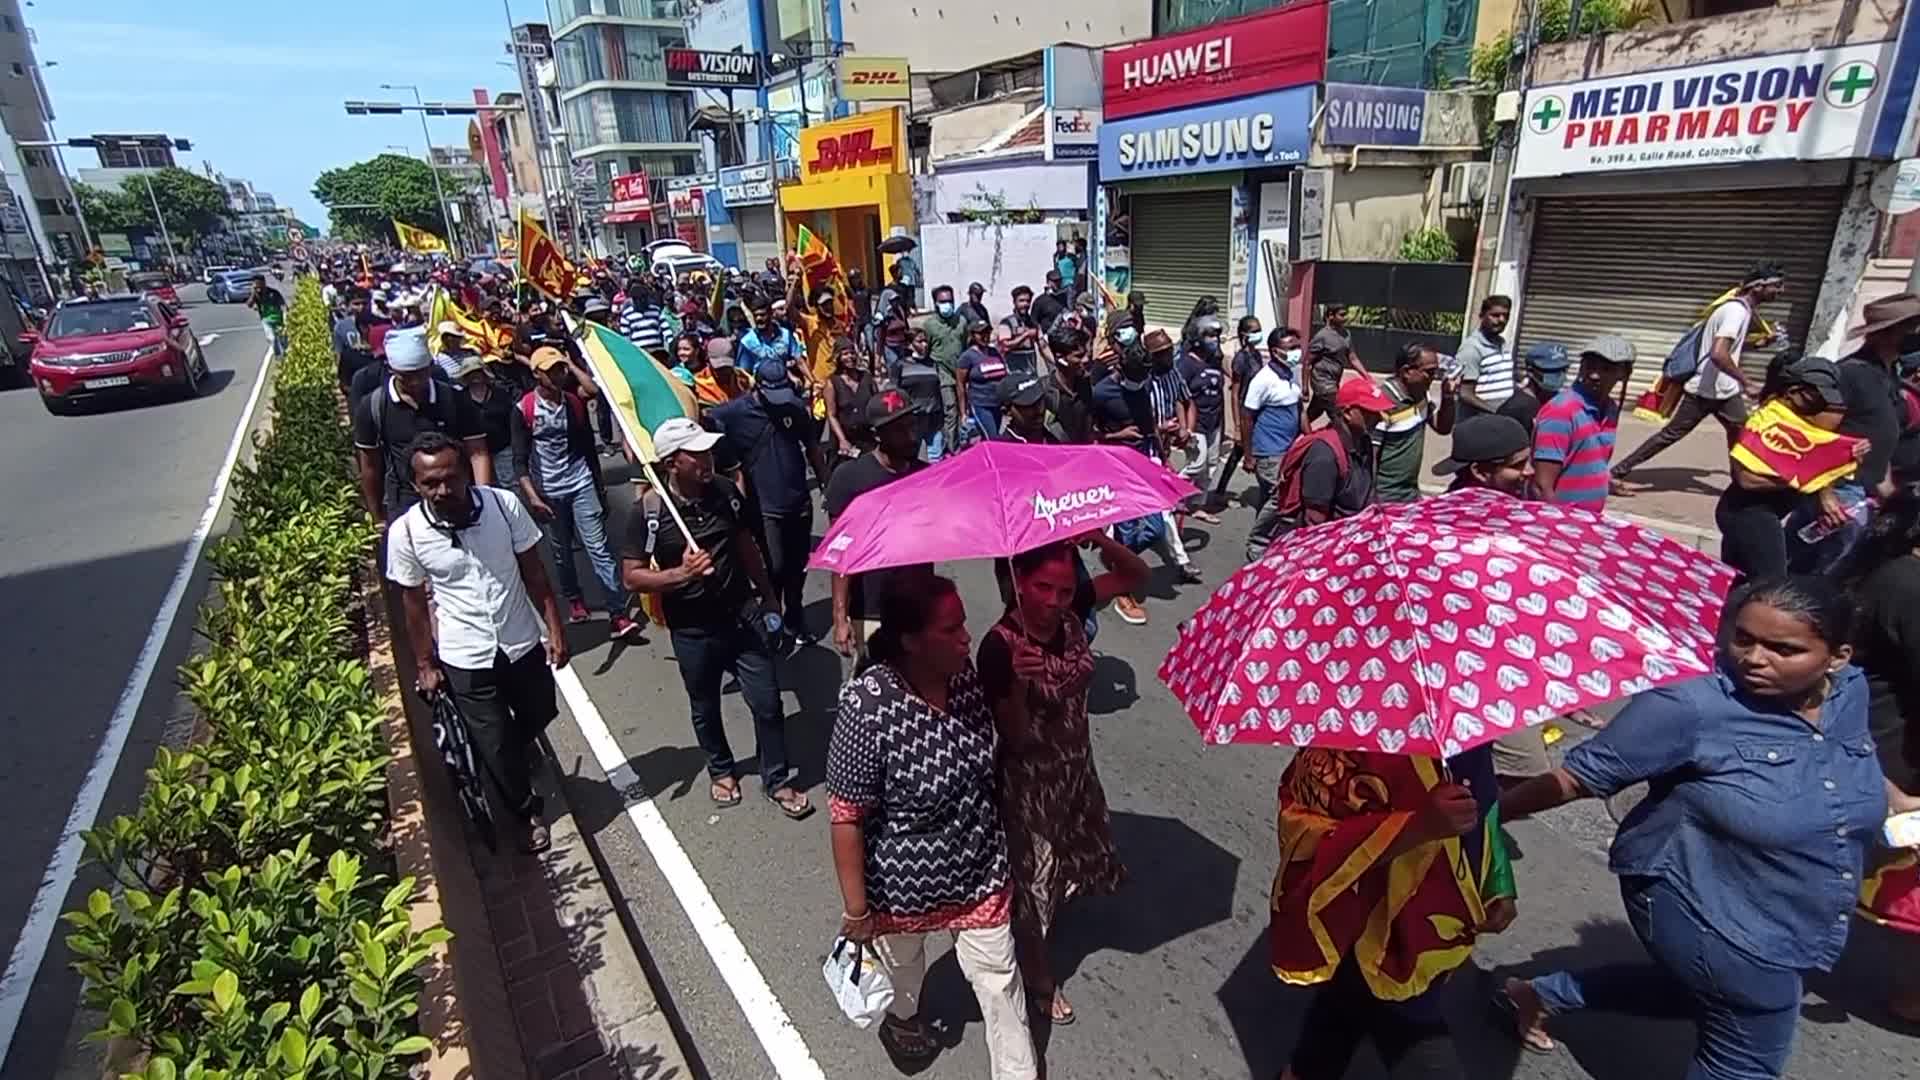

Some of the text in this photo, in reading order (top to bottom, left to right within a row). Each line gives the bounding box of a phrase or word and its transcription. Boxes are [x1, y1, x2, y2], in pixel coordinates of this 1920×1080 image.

[667, 53, 754, 75] HIKVISION
[851, 71, 900, 85] DHL
[1123, 36, 1233, 90] HUAWEI
[1568, 63, 1825, 120] MEDI VISION
[1055, 115, 1092, 133] FedEx
[1329, 98, 1421, 131] SAMSUNG
[1563, 101, 1813, 149] PHARMACY
[808, 127, 893, 176] DHL
[1118, 112, 1274, 167] SAMSUNG
[1279, 150, 1300, 161] Tech
